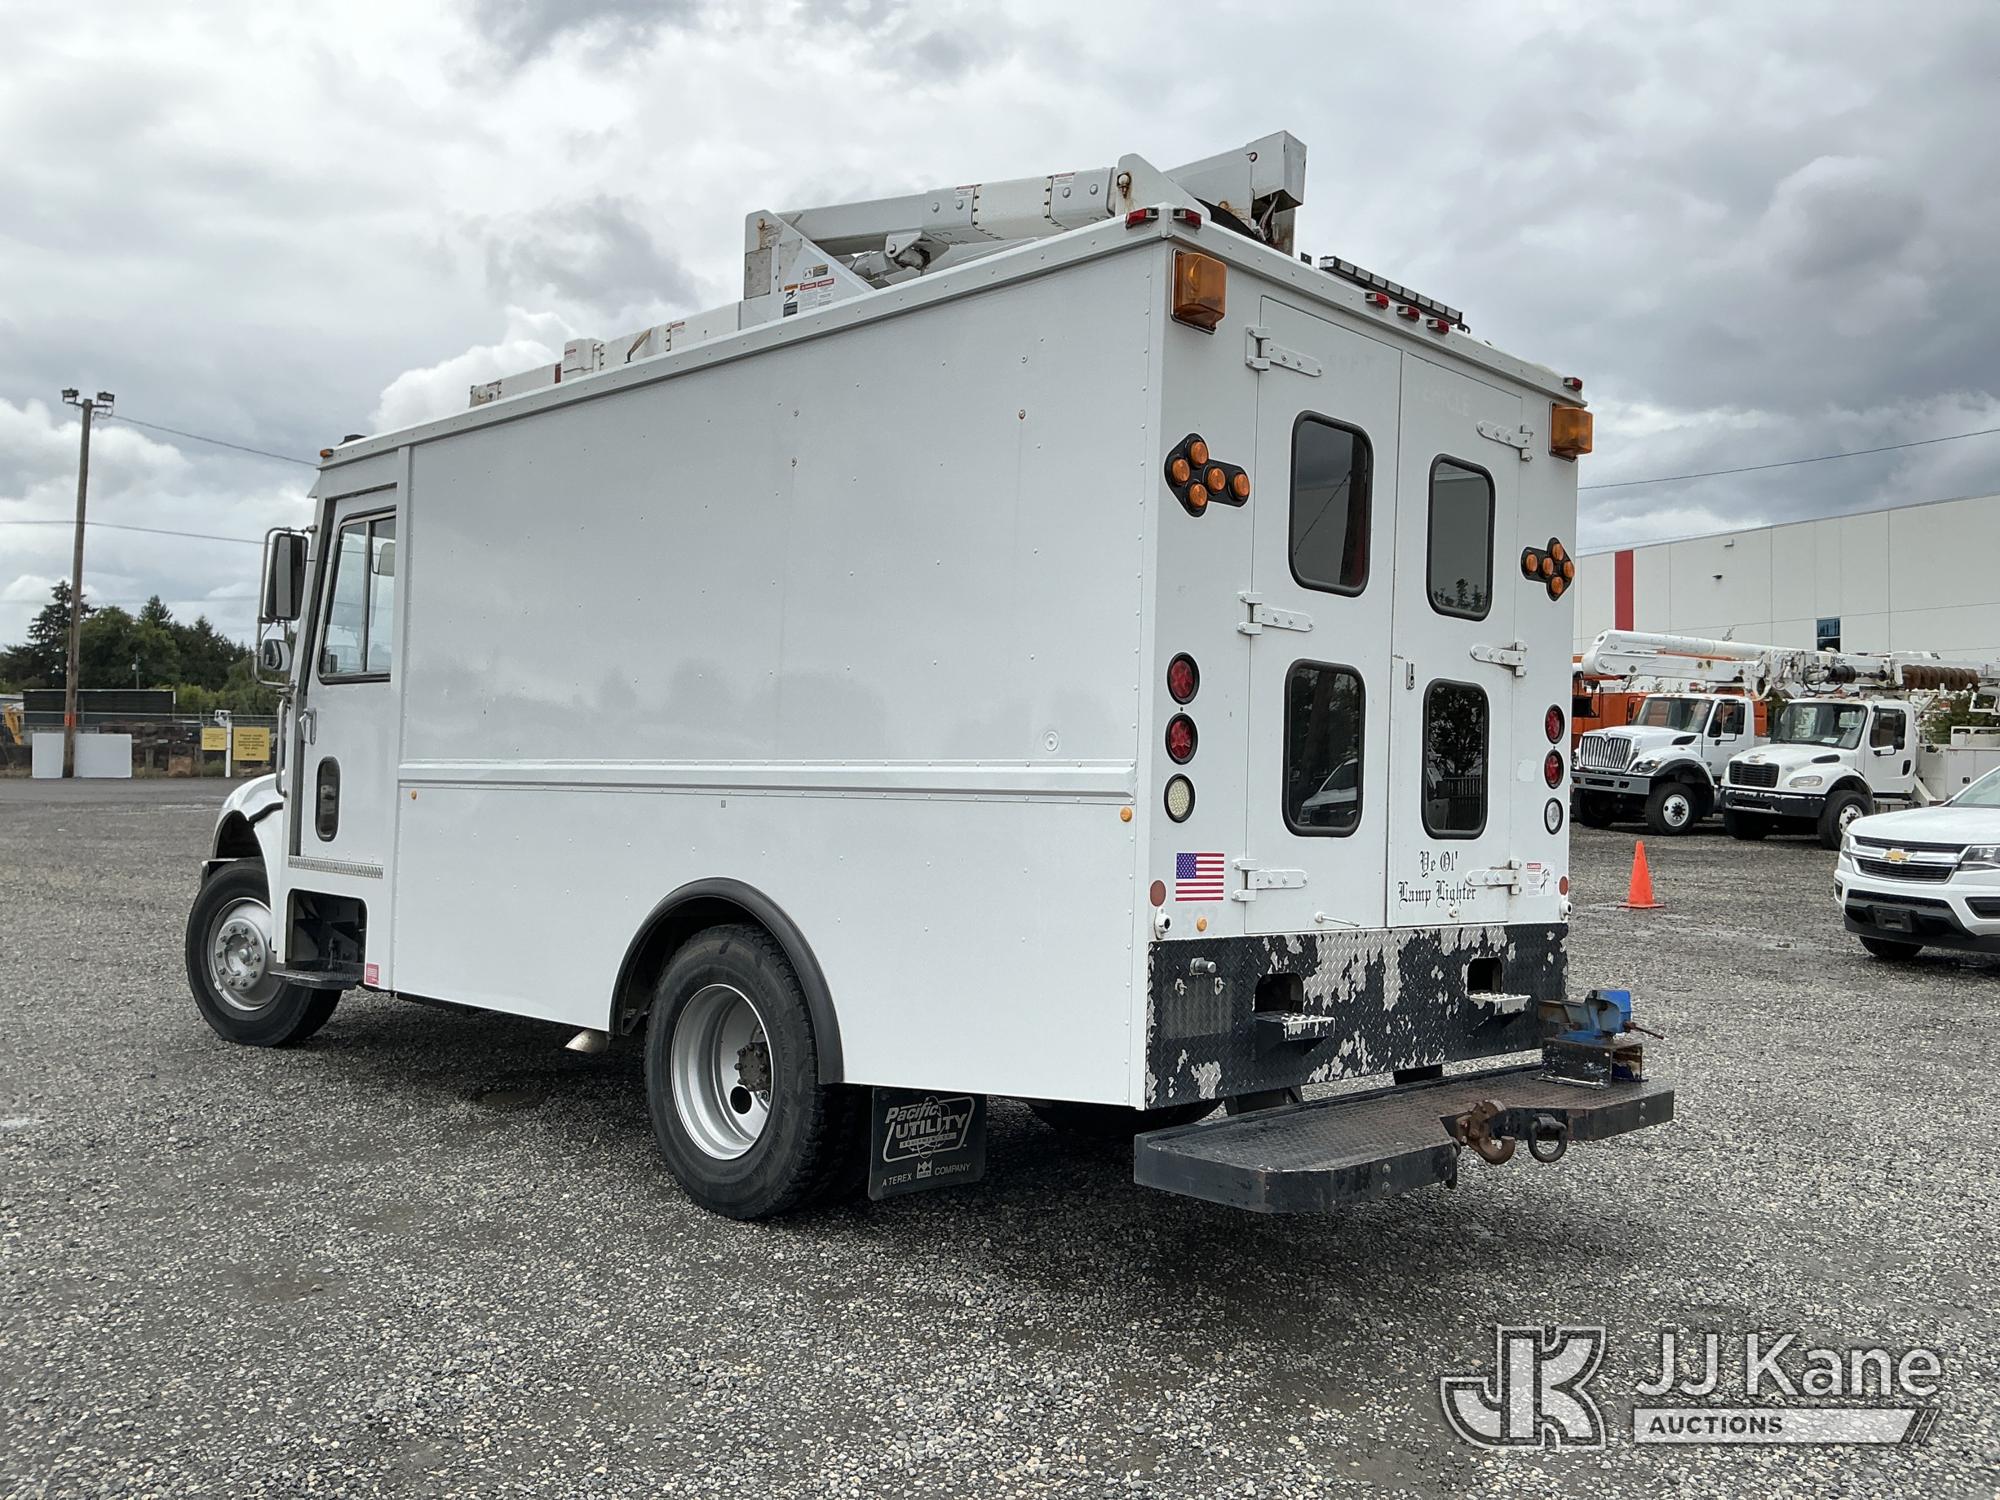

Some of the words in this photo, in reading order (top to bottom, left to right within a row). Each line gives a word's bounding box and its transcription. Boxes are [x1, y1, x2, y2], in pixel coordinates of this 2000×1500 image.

[1419, 850, 1436, 879] Ye
[1439, 850, 1458, 872] Ol'
[1397, 880, 1431, 909] Lamp
[1435, 880, 1477, 908] Lighter
[885, 1101, 939, 1124] Pacific
[895, 1113, 968, 1139] UTILITY
[881, 1178, 887, 1188] A
[888, 1172, 913, 1186] TEREX
[934, 1162, 972, 1176] COMPANY
